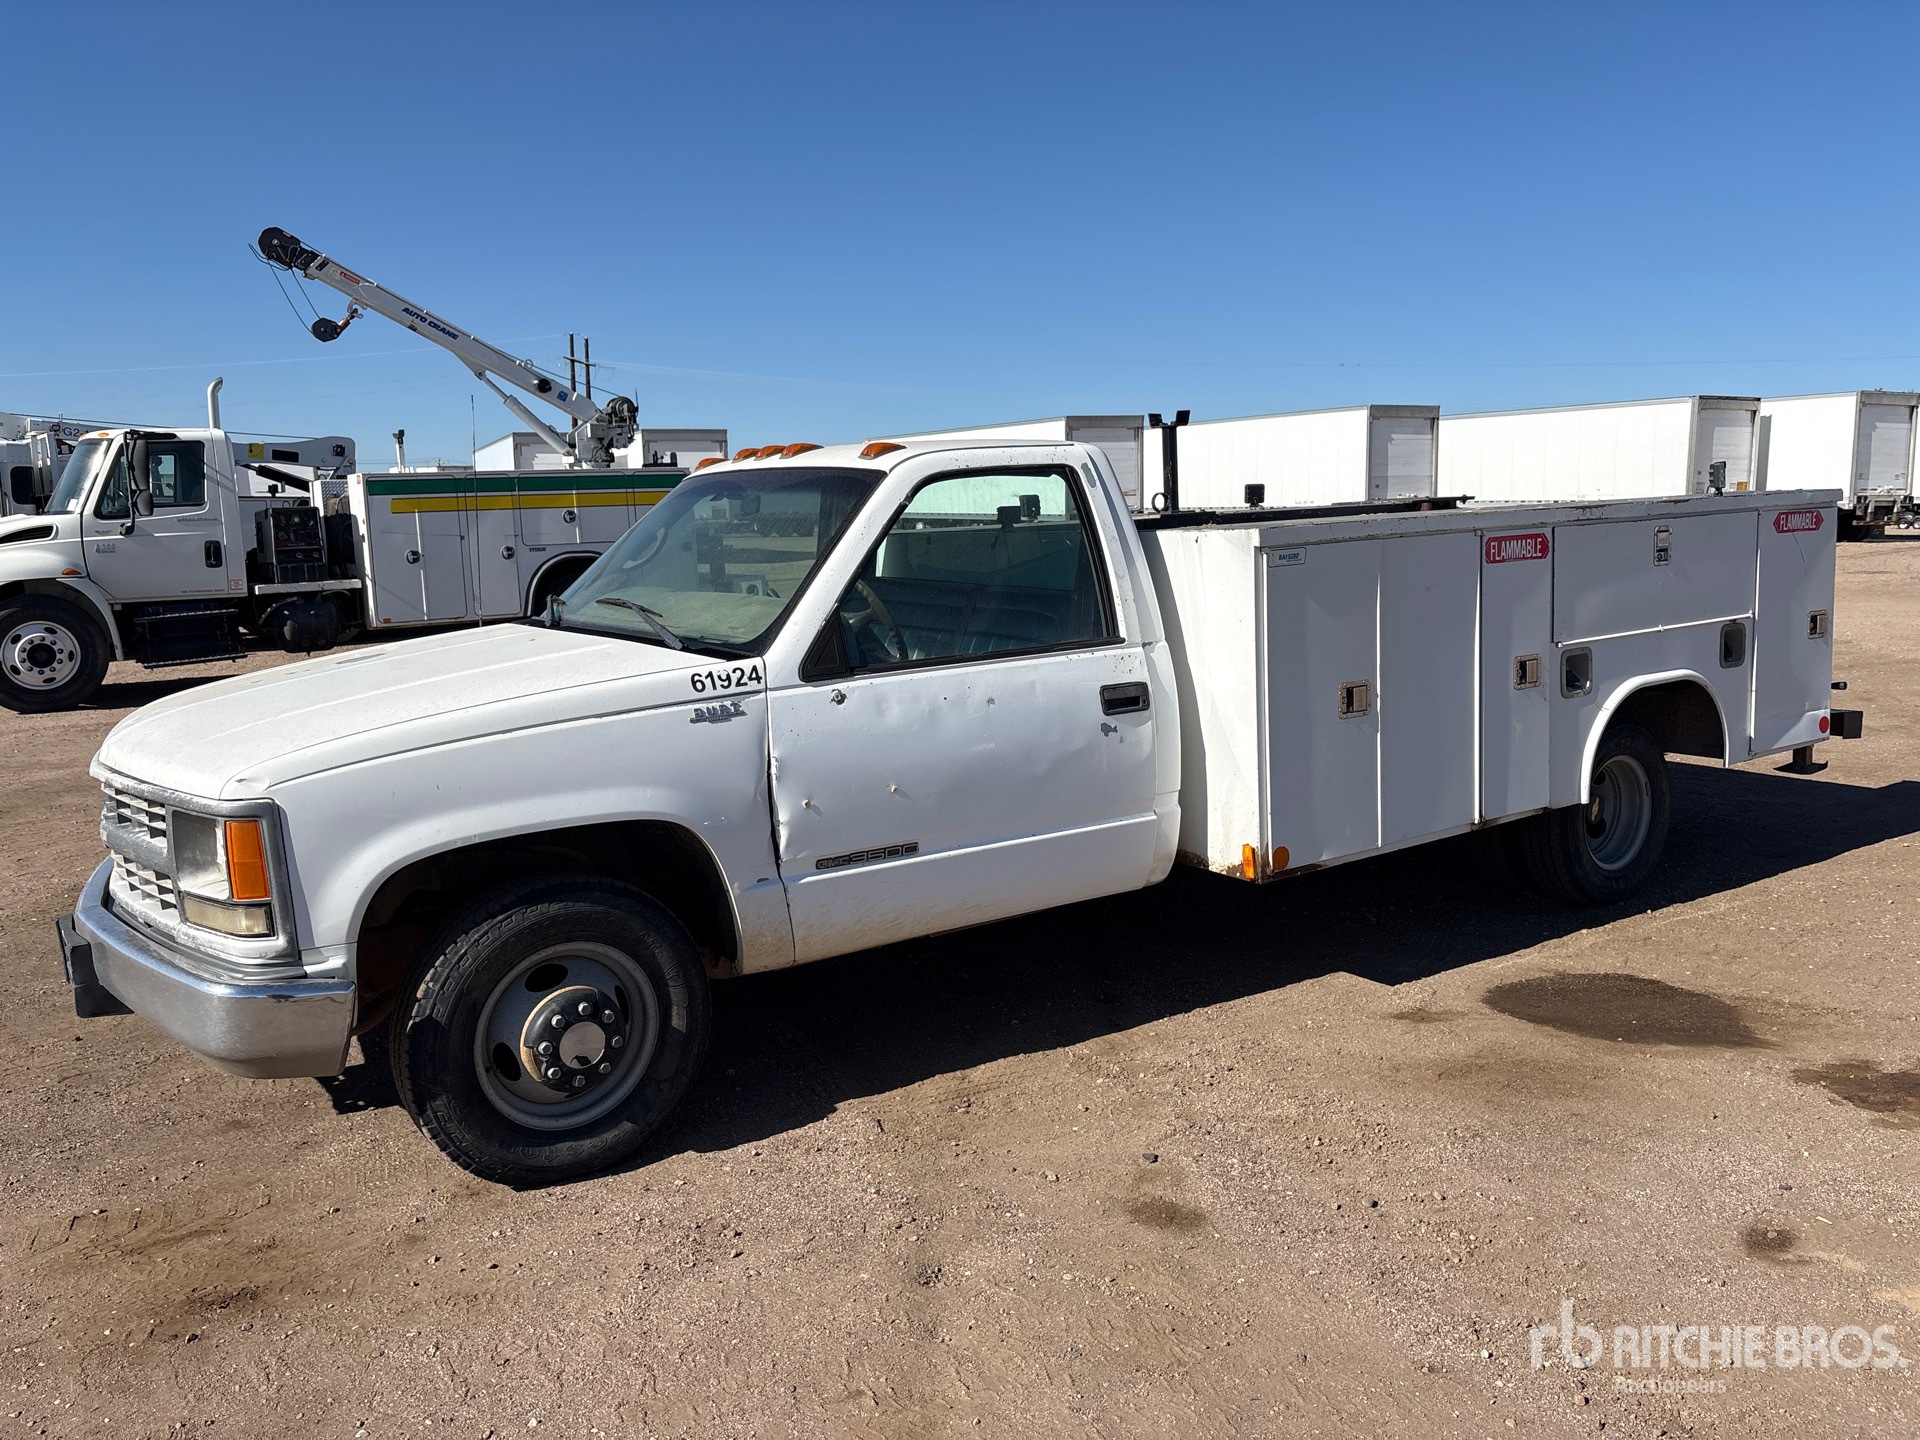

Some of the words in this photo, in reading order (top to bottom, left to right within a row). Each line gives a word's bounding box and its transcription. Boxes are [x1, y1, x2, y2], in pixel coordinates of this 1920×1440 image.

[401, 307, 428, 323] AUTO
[427, 320, 459, 340] CRANE
[1780, 511, 1817, 531] FLAMMABLE
[1490, 537, 1543, 561] FLAMMABLE
[690, 664, 763, 693] 61924
[849, 842, 920, 864] 3500
